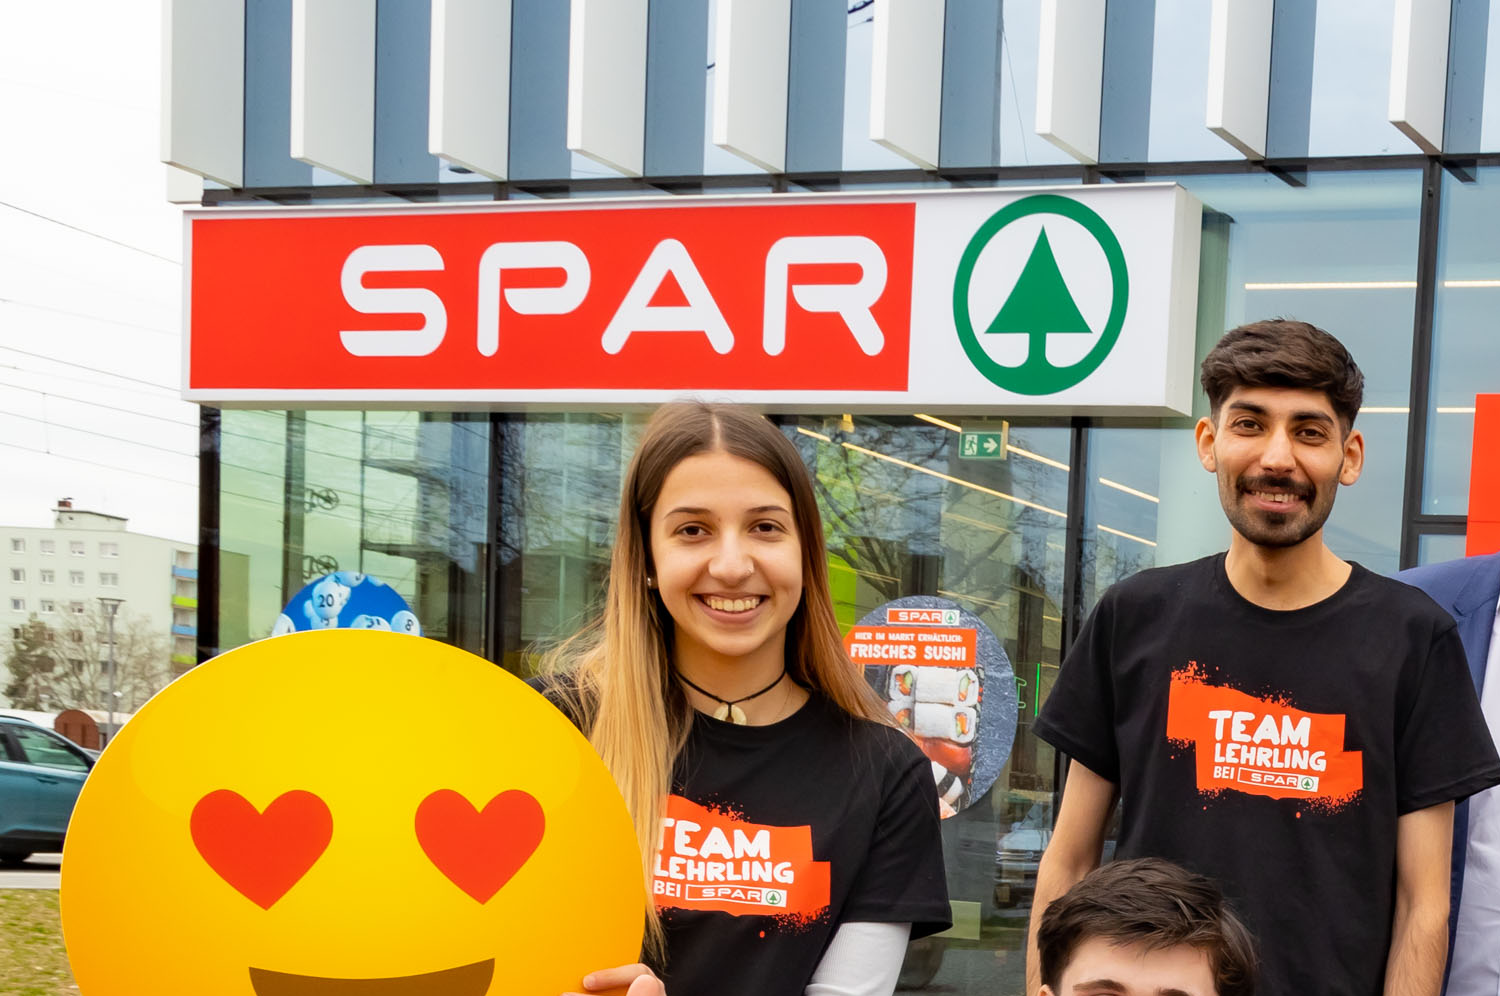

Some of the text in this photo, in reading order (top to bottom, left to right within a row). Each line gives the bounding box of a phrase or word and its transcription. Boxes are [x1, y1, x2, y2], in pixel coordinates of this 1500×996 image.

[339, 235, 888, 357] SPAR
[319, 594, 334, 607] 20
[405, 619, 414, 631] 8
[898, 612, 942, 622] SPAR
[855, 632, 872, 640] HIER
[875, 633, 885, 641] IM
[888, 633, 915, 642] MARKT
[850, 644, 967, 661] FRISCHES SUSHI
[1208, 710, 1311, 748] TEAM
[1214, 743, 1327, 772] LEHRLING
[1213, 766, 1298, 787] BEI SPAR
[654, 854, 795, 884] LEHRLING
[654, 880, 762, 901] BEI SPAR
